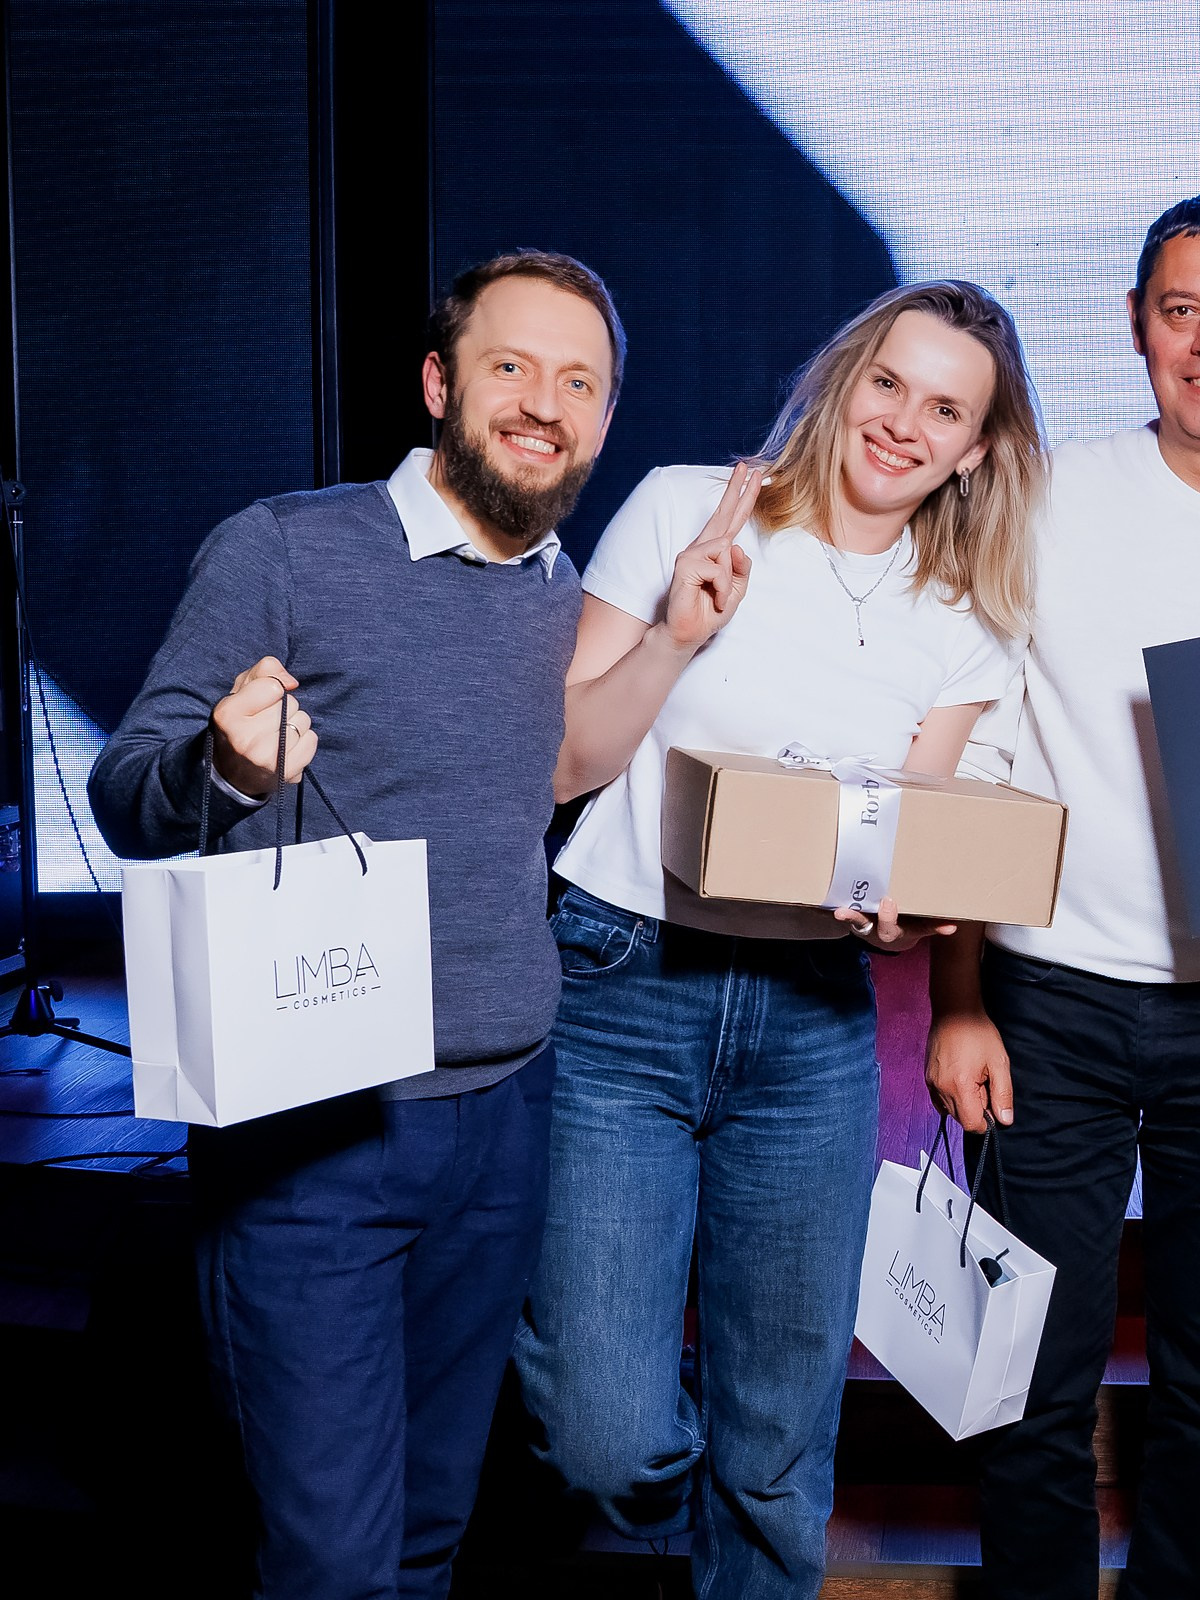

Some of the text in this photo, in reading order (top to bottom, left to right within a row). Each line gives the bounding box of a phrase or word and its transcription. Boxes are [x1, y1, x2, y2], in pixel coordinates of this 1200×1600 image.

[274, 943, 379, 998] LIMBA
[294, 986, 366, 1009] COSMETICS
[888, 1250, 945, 1336] LIMBA
[894, 1287, 933, 1336] COSMETICS
